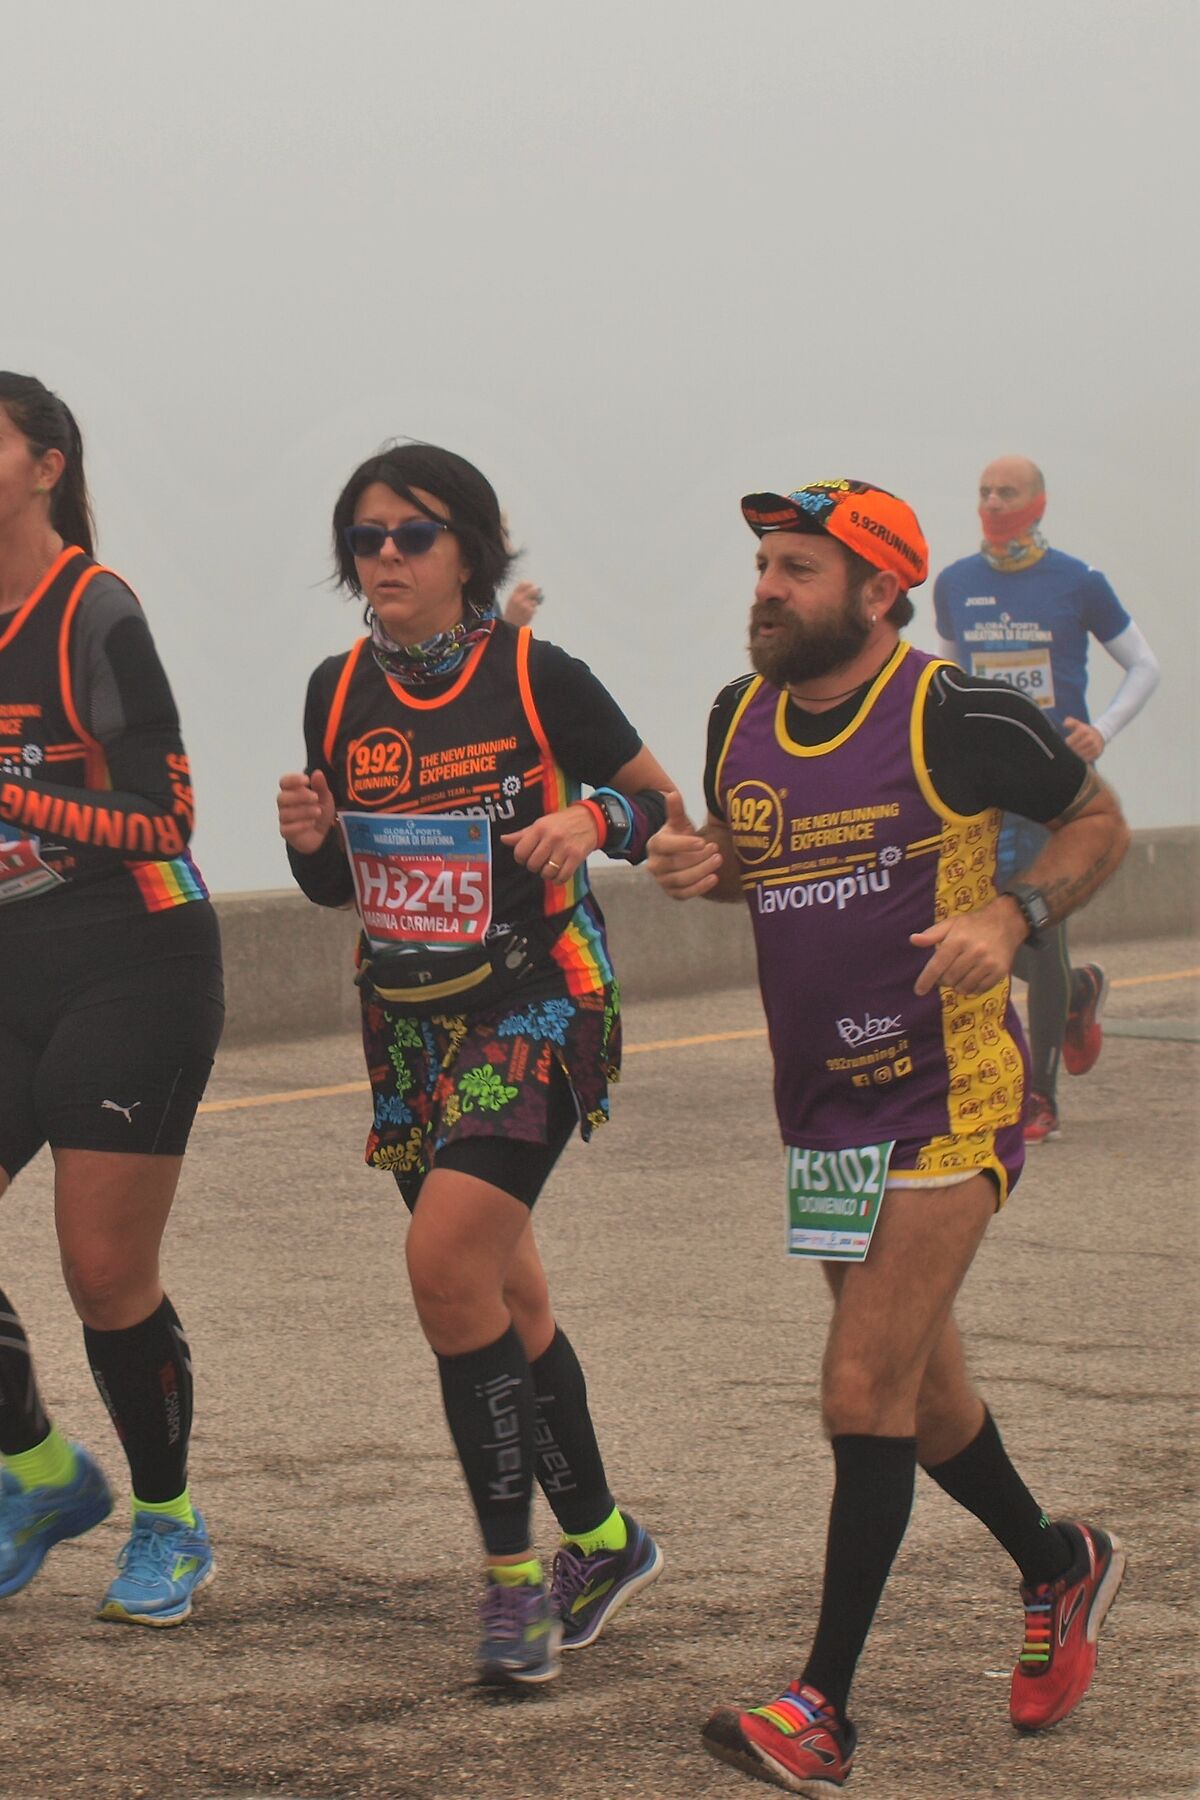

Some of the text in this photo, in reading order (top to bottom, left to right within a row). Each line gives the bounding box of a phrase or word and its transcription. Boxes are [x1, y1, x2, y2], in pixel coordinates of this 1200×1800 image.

[419, 735, 518, 770] THE NEW RUNNING
[354, 775, 400, 792] RUNNING
[419, 754, 498, 787] EXPERIENCE
[790, 802, 900, 833] THE NEW RUNNING
[790, 821, 875, 852] EXPERIENCE
[359, 861, 484, 914] H3245
[363, 911, 460, 933] MARINA CARMELA
[790, 1146, 880, 1193] H3102
[475, 1374, 522, 1500] Kalenji
